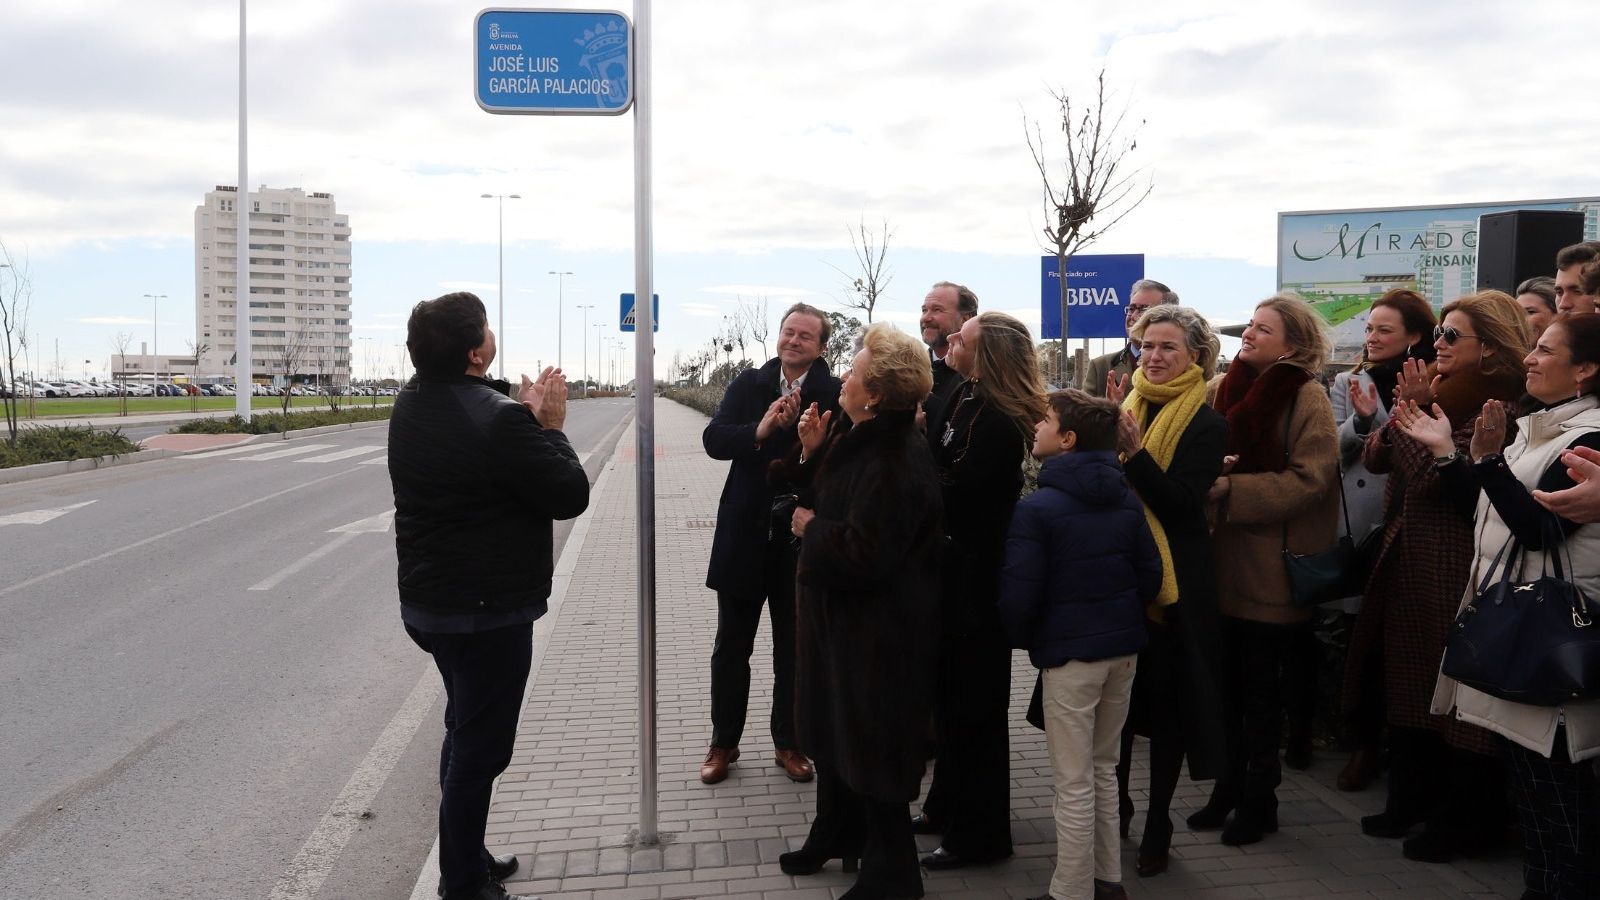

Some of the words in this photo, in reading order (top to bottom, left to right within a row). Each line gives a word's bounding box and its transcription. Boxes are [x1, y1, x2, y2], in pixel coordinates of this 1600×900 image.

[489, 43, 522, 51] AVENIDA
[488, 54, 525, 73] JOSÉ
[528, 57, 559, 73] LUIS
[489, 75, 540, 94] GARCÍA
[544, 78, 610, 95] PALACIOS
[1425, 254, 1477, 267] ENSAN
[1084, 271, 1098, 279] por:
[1066, 287, 1120, 306] BBVA
